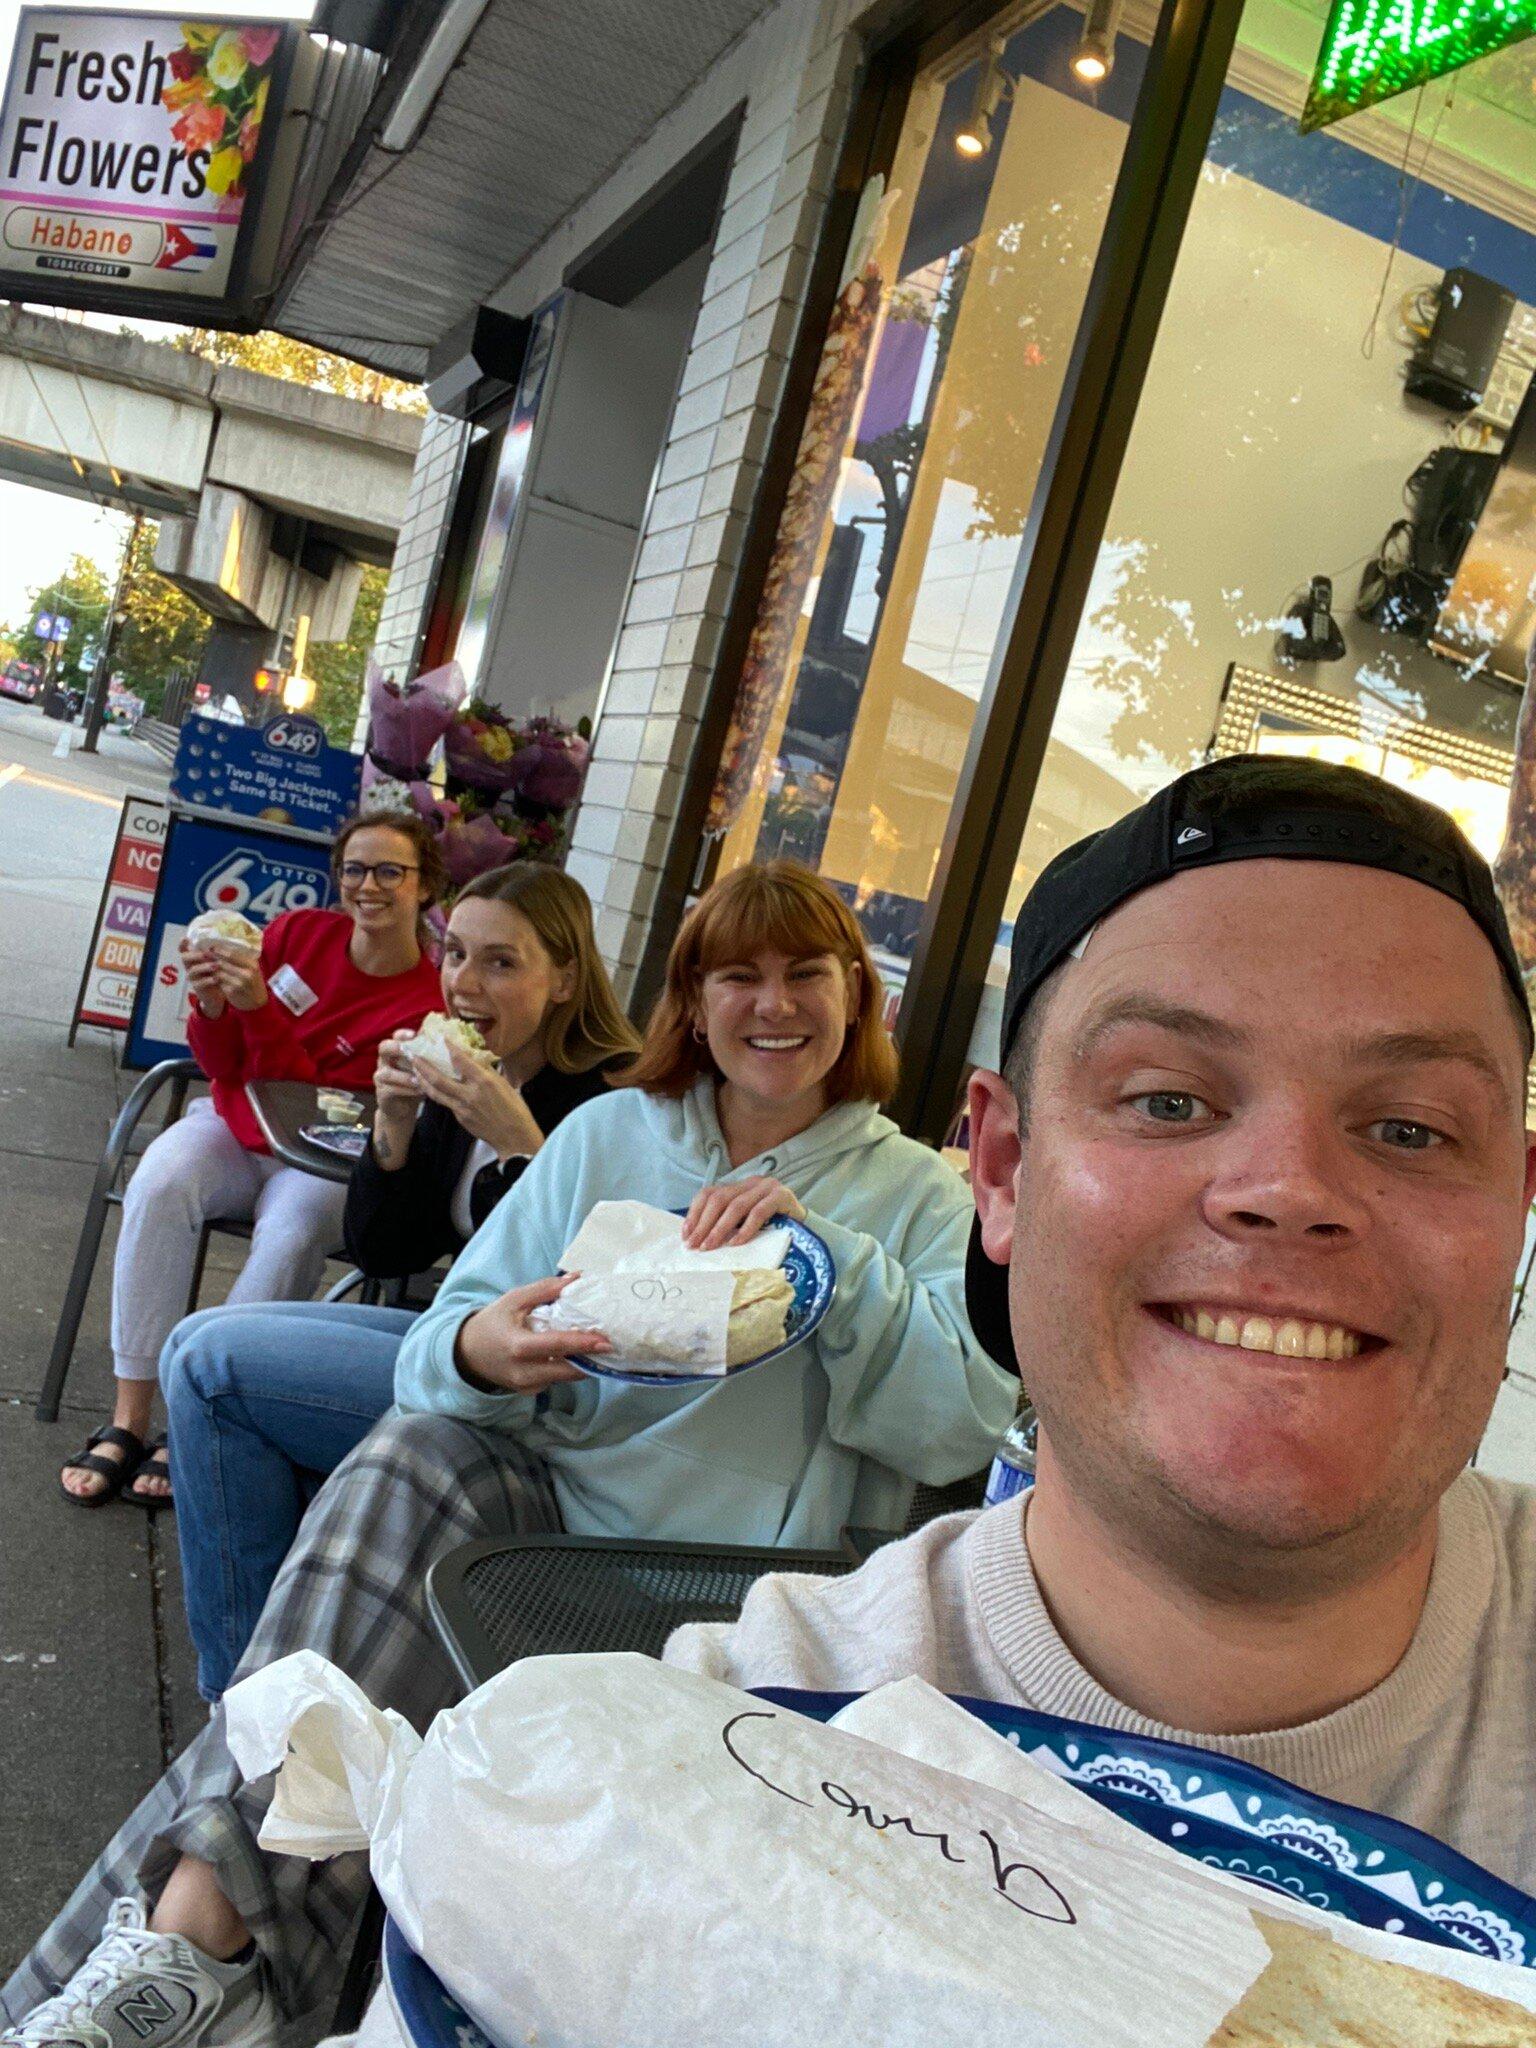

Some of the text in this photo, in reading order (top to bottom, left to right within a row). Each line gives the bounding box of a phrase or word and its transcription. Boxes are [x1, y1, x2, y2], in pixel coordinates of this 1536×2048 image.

[24, 32, 167, 105] Fresh
[8, 117, 211, 199] Flowers
[30, 216, 133, 254] Habano
[47, 258, 120, 276] TOBACCONIST
[225, 763, 341, 803] Two Big Jackpots,
[229, 780, 267, 798] Same
[269, 790, 286, 803] $3
[261, 864, 318, 883] LOTTO
[116, 903, 151, 927] VA
[115, 1984, 176, 2038] N
